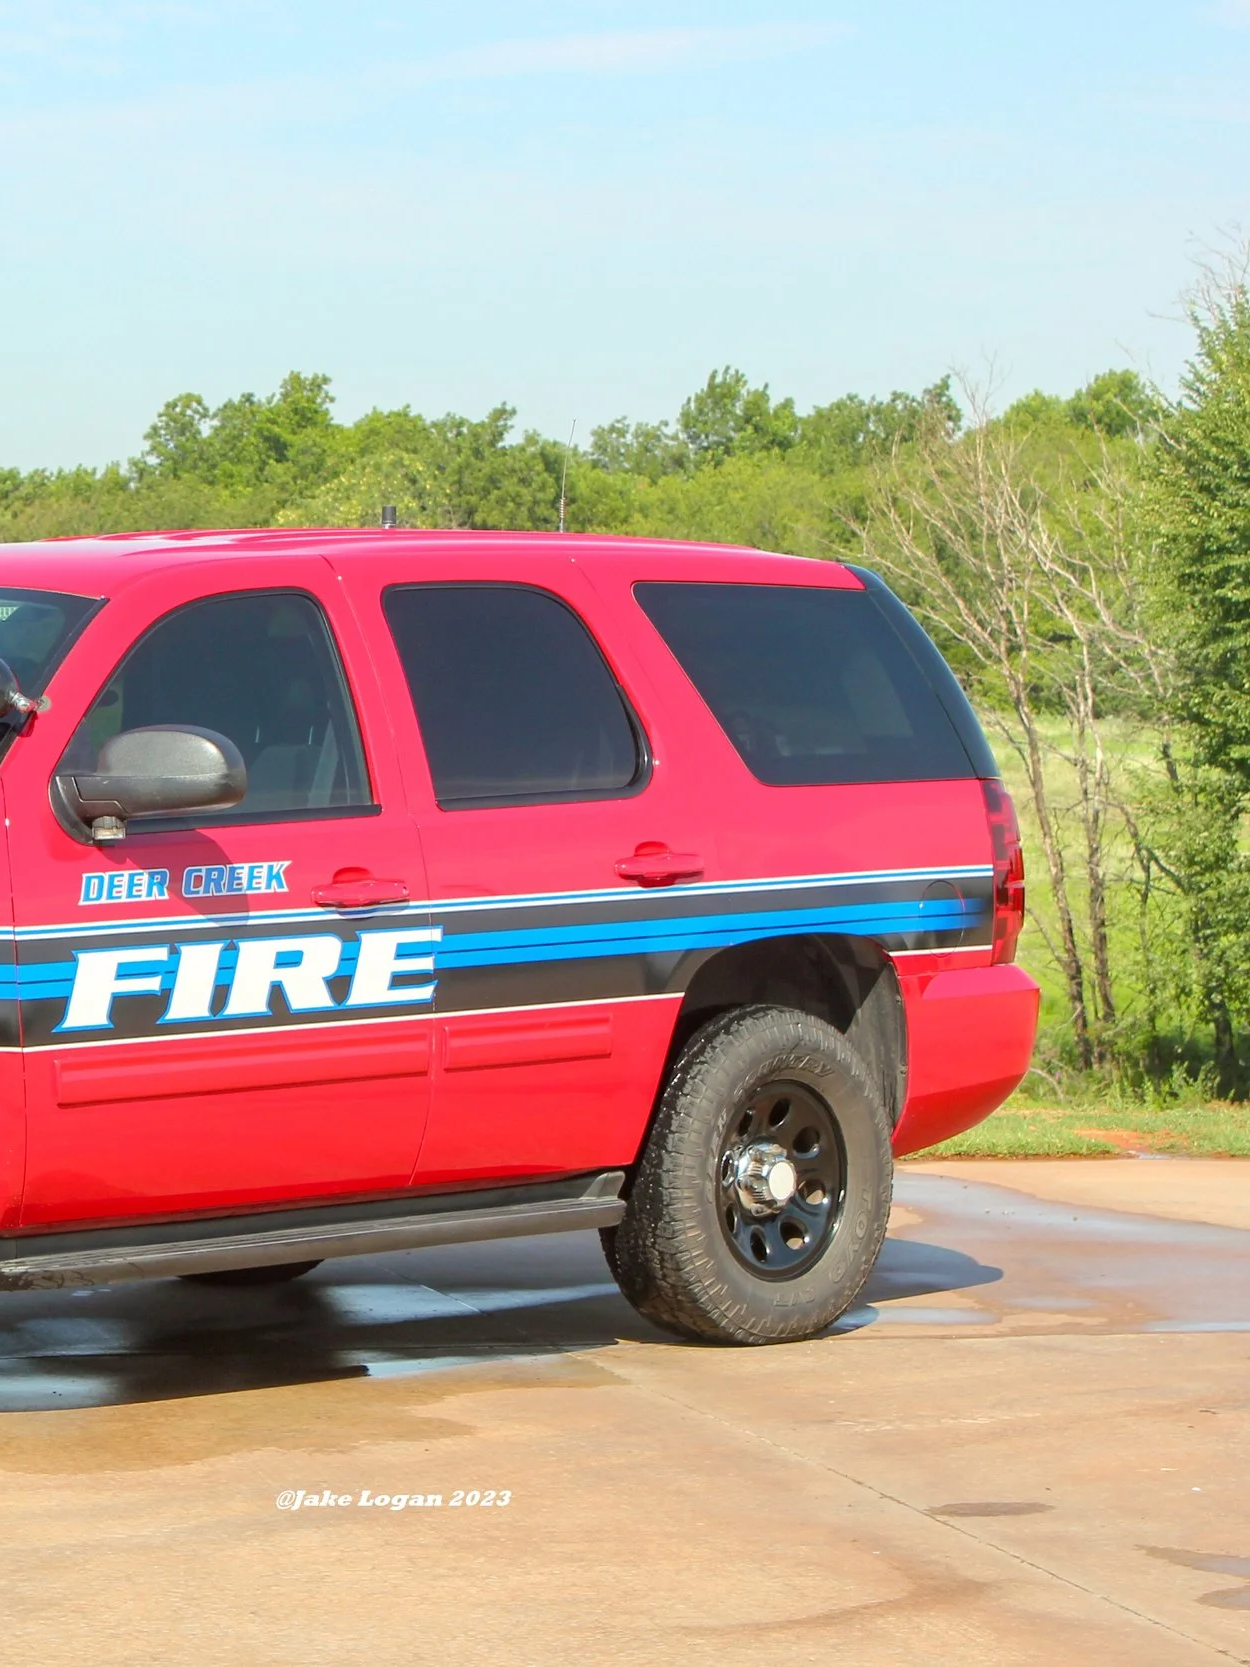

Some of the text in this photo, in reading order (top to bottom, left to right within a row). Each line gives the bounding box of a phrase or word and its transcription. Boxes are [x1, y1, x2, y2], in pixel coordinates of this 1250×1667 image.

[78, 860, 293, 906] DEER CREEK
[51, 925, 444, 1033] FIRE
